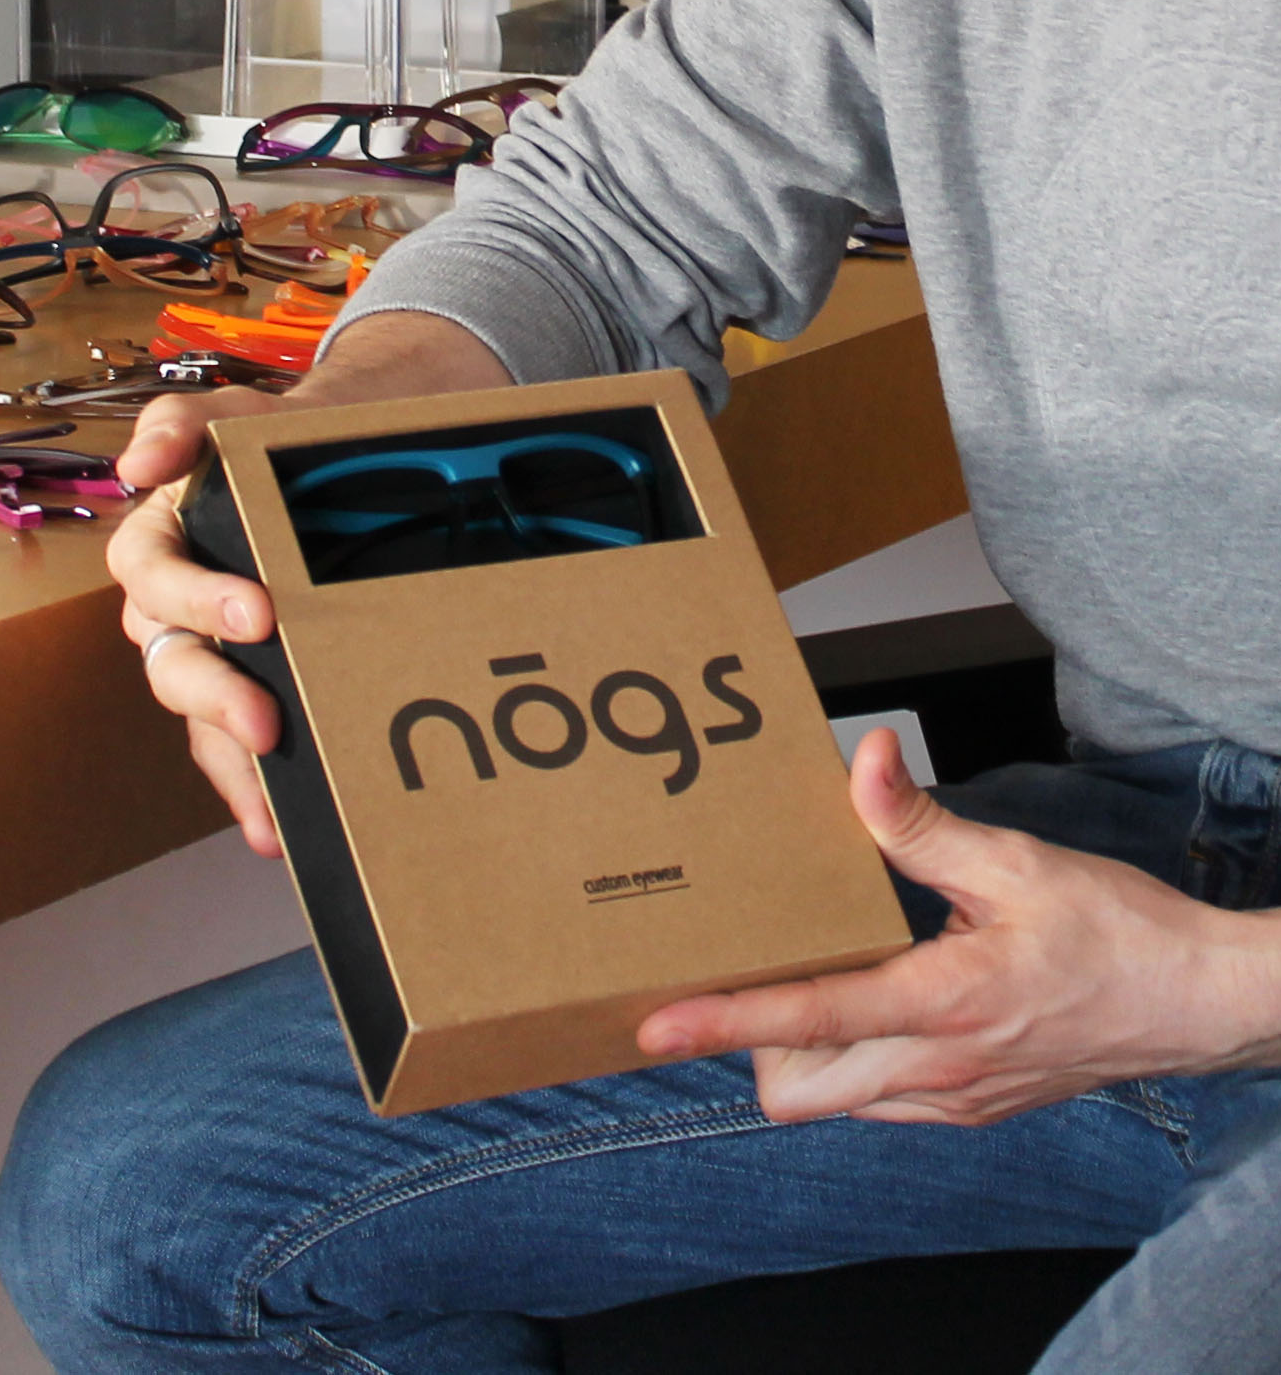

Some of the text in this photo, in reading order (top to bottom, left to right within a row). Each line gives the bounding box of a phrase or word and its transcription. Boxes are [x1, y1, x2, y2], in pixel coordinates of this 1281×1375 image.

[389, 652, 763, 796] nōgs
[583, 865, 683, 894] custom eyewear
